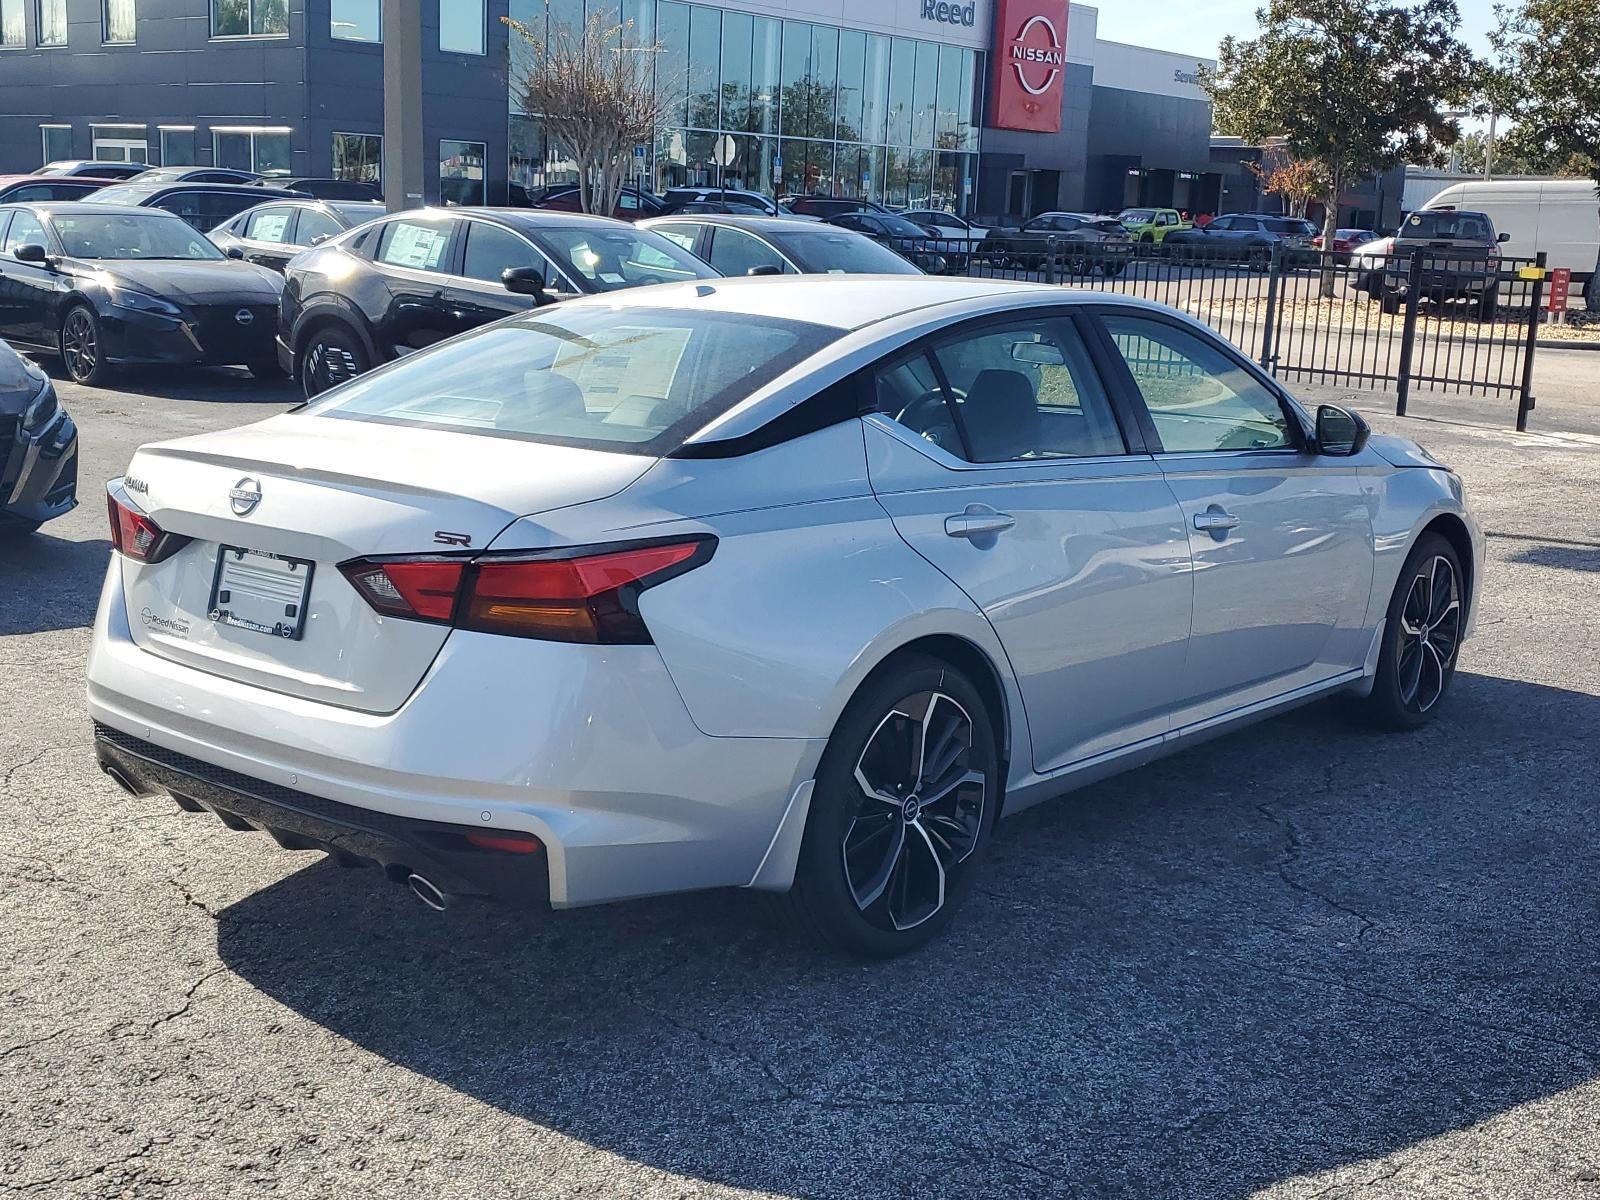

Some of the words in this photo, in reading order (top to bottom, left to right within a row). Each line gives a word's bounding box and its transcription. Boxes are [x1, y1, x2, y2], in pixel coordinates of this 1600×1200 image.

[921, 0, 975, 26] Reed
[1013, 45, 1062, 65] NISSAN
[433, 530, 472, 548] SR
